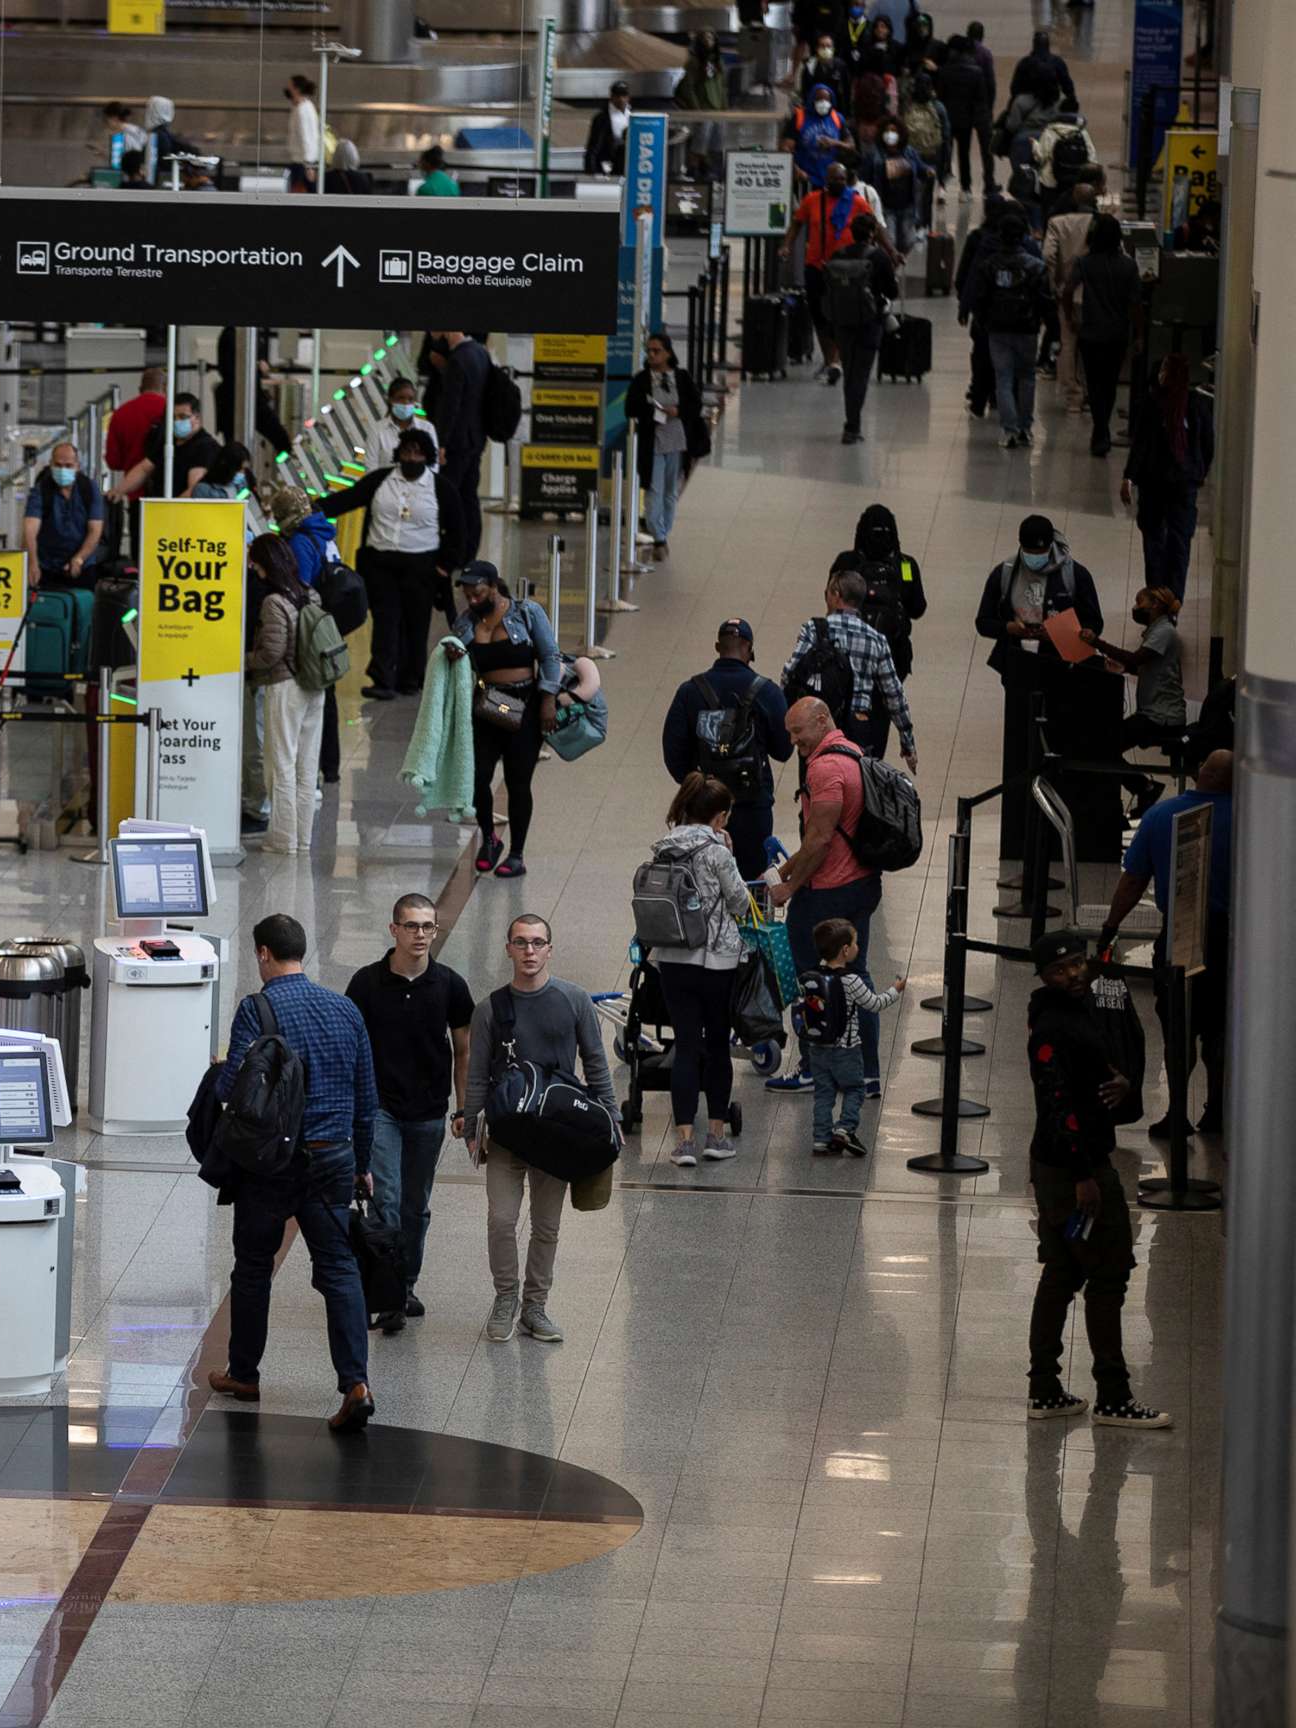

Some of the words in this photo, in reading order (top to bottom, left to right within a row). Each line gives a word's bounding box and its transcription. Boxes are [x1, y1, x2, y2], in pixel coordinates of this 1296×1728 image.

[638, 131, 655, 174] BAG
[735, 177, 753, 187] 40
[756, 177, 782, 188] LBS
[54, 242, 135, 263] Ground
[142, 244, 304, 268] Transportation
[417, 251, 516, 276] Baggage
[522, 253, 584, 274] Claim
[54, 265, 114, 279] Transporte
[116, 267, 163, 279] Terrestre
[416, 273, 465, 286] Reclamo
[467, 275, 481, 286] de
[484, 275, 532, 289] Equipaje
[542, 472, 577, 485] Charge
[540, 484, 578, 496] Applies
[157, 538, 227, 557] Self-Tag
[157, 556, 228, 581] Your
[158, 584, 225, 621] Bag
[182, 719, 217, 732] Your
[159, 753, 187, 765] ass
